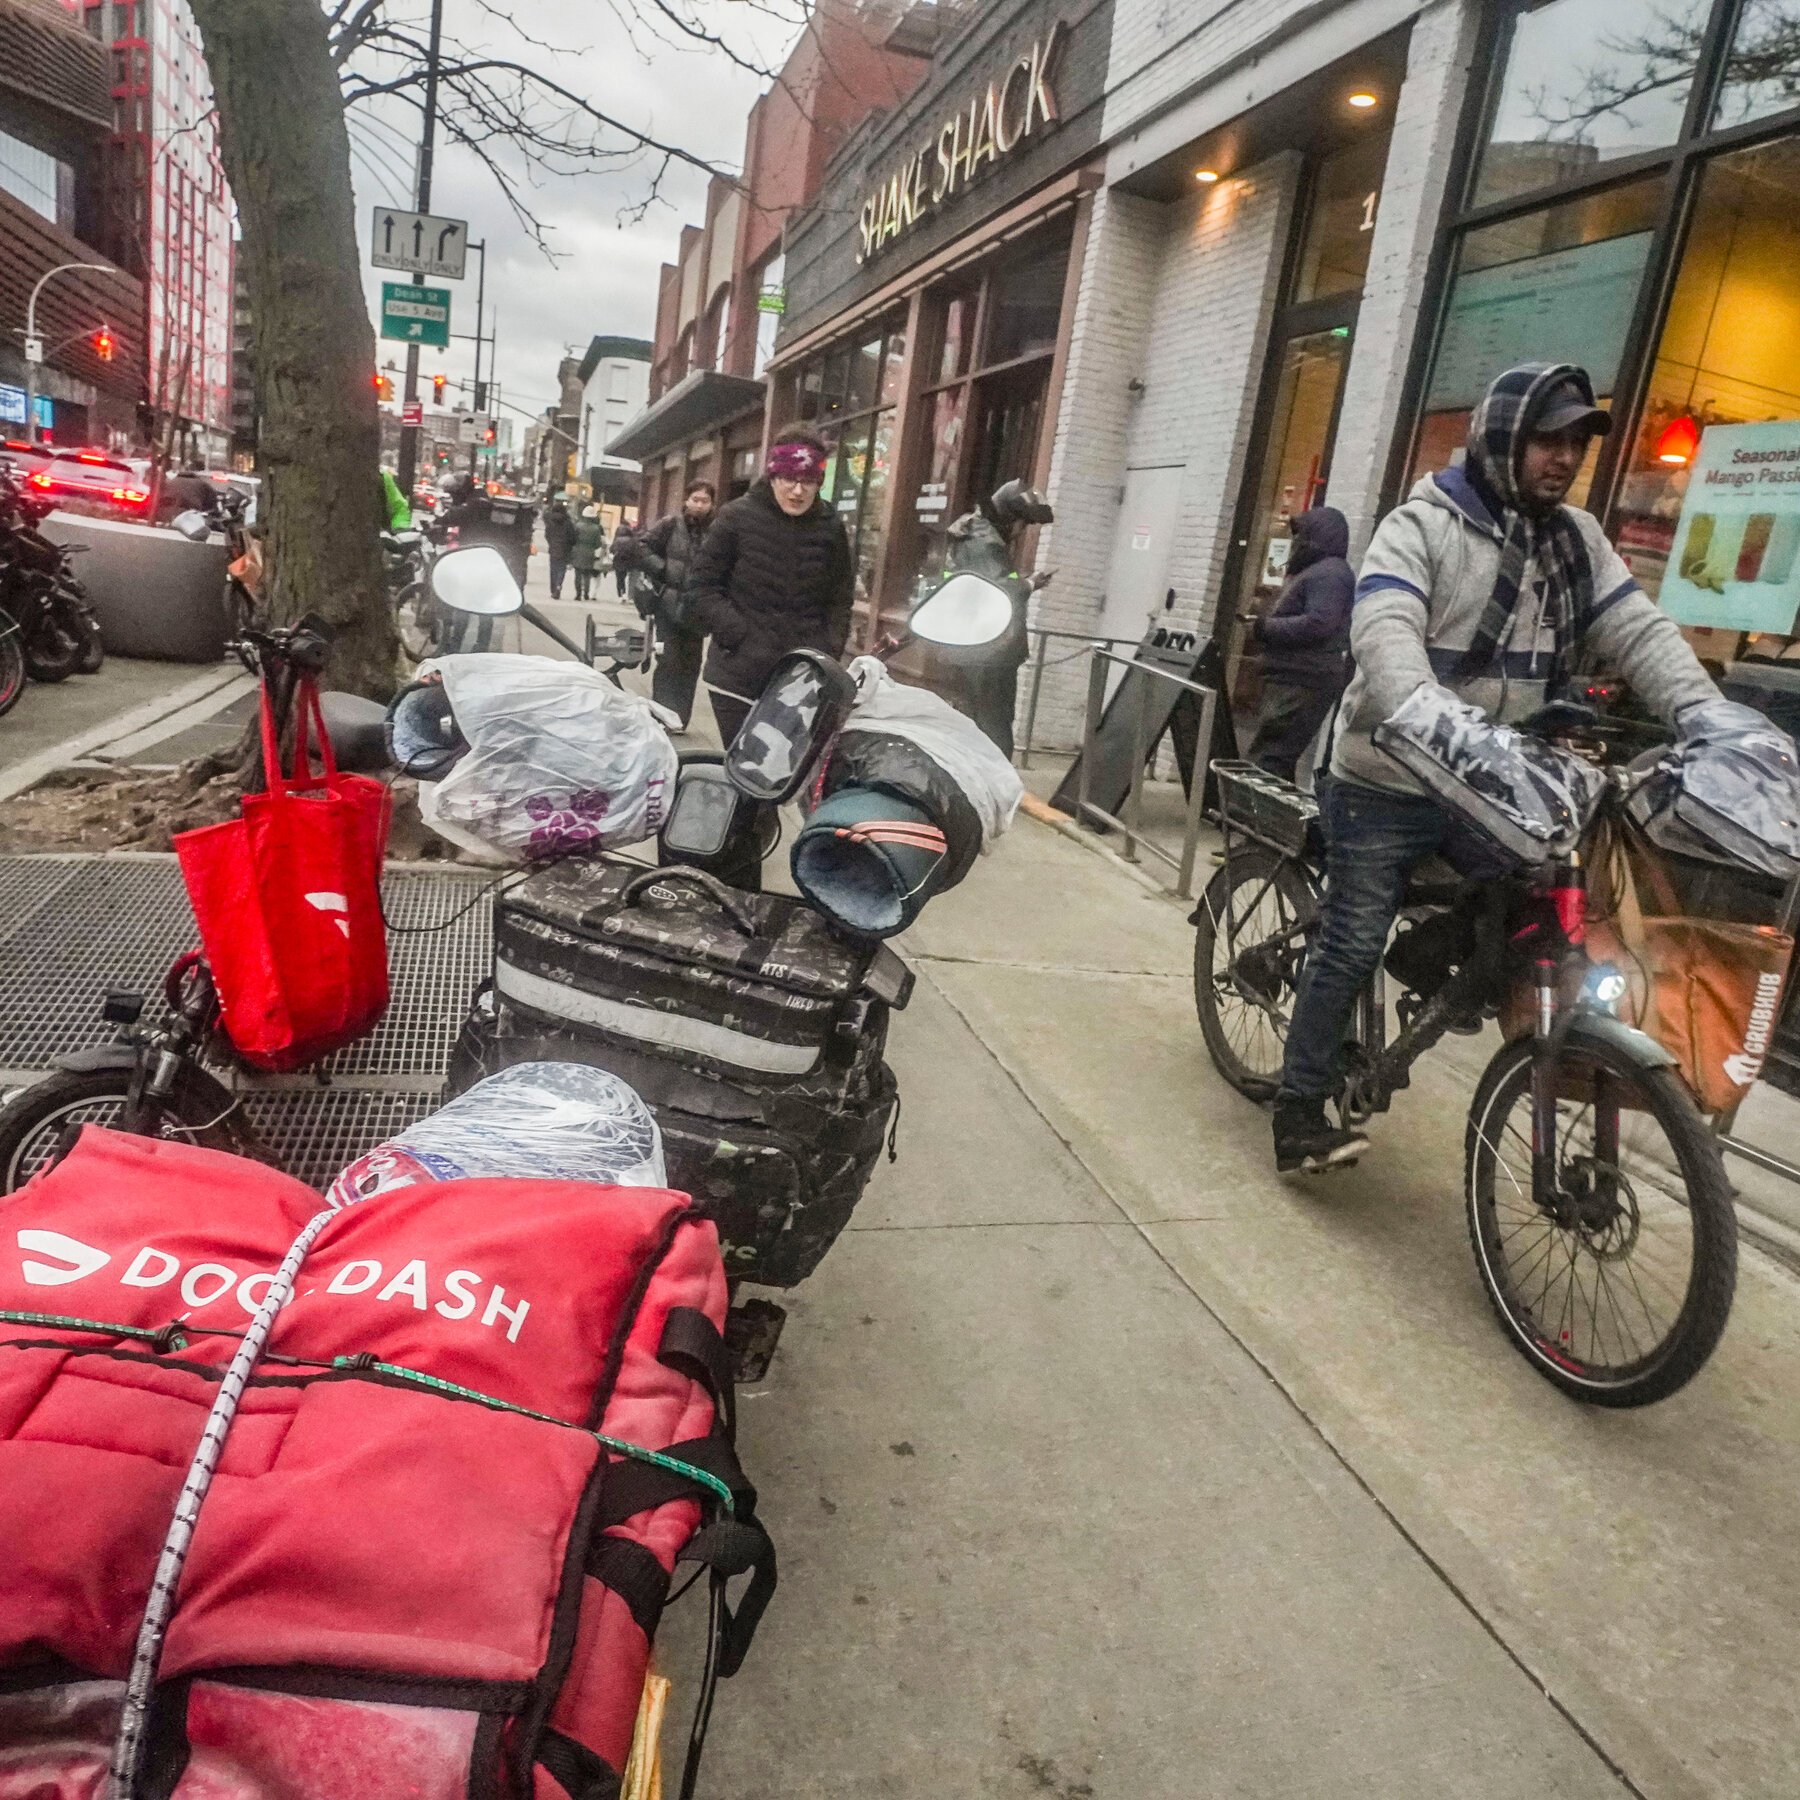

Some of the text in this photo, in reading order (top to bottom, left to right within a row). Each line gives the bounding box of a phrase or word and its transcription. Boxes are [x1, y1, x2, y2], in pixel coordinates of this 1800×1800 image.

[856, 22, 1060, 264] SHAKE SHACK
[374, 254, 400, 267] ONLY
[403, 257, 428, 271] ONLY
[434, 263, 462, 275] ONLY
[394, 287, 438, 302] Dean St
[1705, 469, 1754, 487] Mango
[1743, 971, 1781, 1055] GRUBHUB
[121, 1246, 531, 1344] DOODASH
